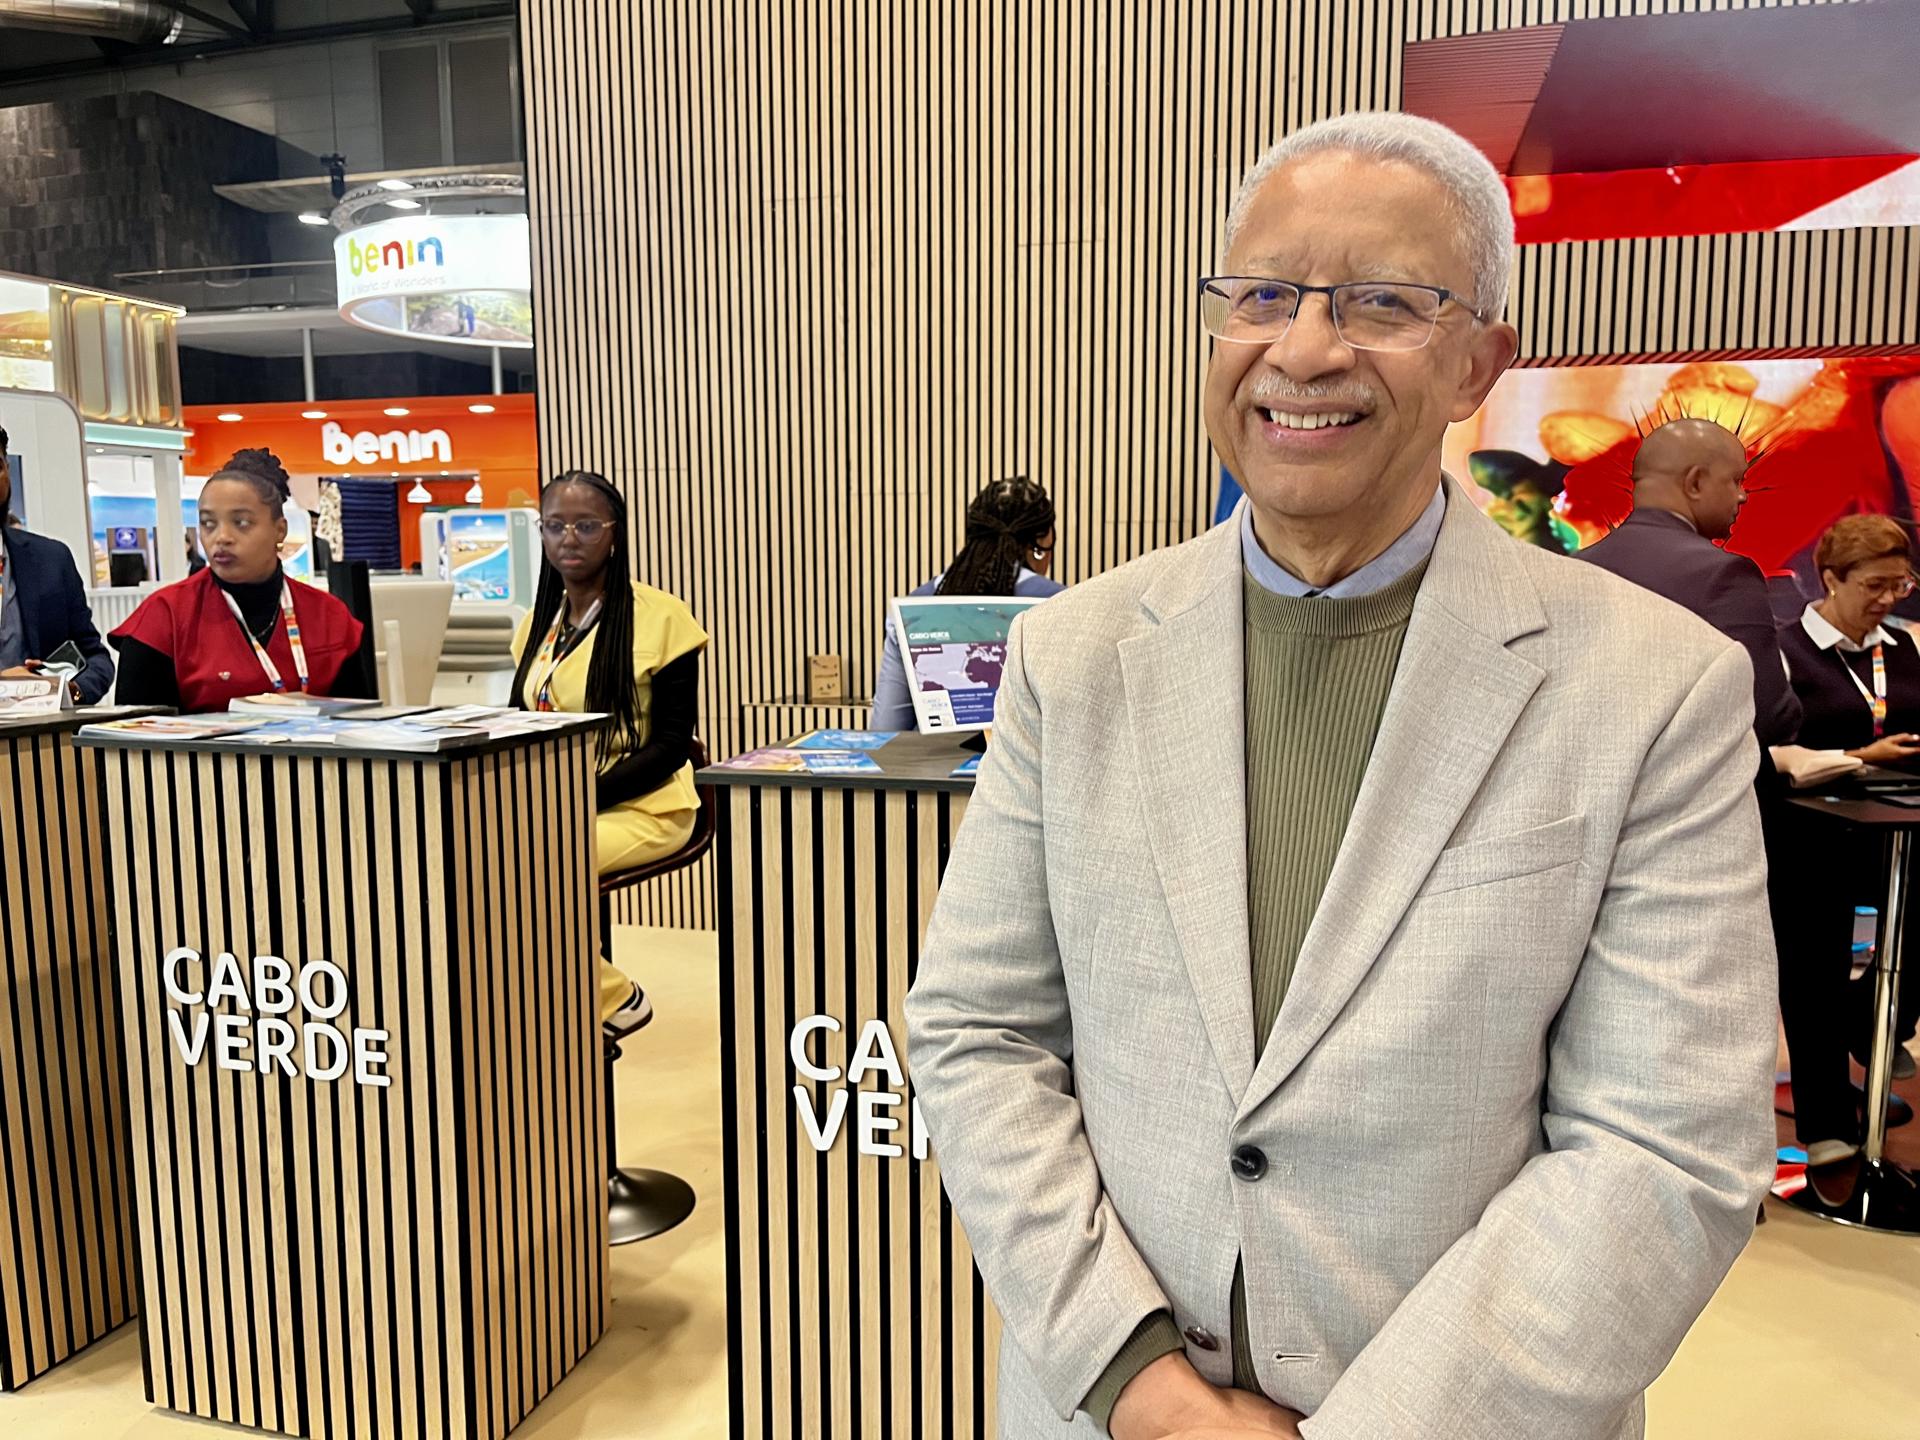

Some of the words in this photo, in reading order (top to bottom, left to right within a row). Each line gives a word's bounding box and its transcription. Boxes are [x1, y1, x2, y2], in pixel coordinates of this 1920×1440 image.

[348, 236, 444, 277] benin
[394, 275, 446, 288] Wonders
[321, 421, 452, 465] benin
[163, 947, 348, 1019] CABO
[168, 1009, 391, 1087] VERDE
